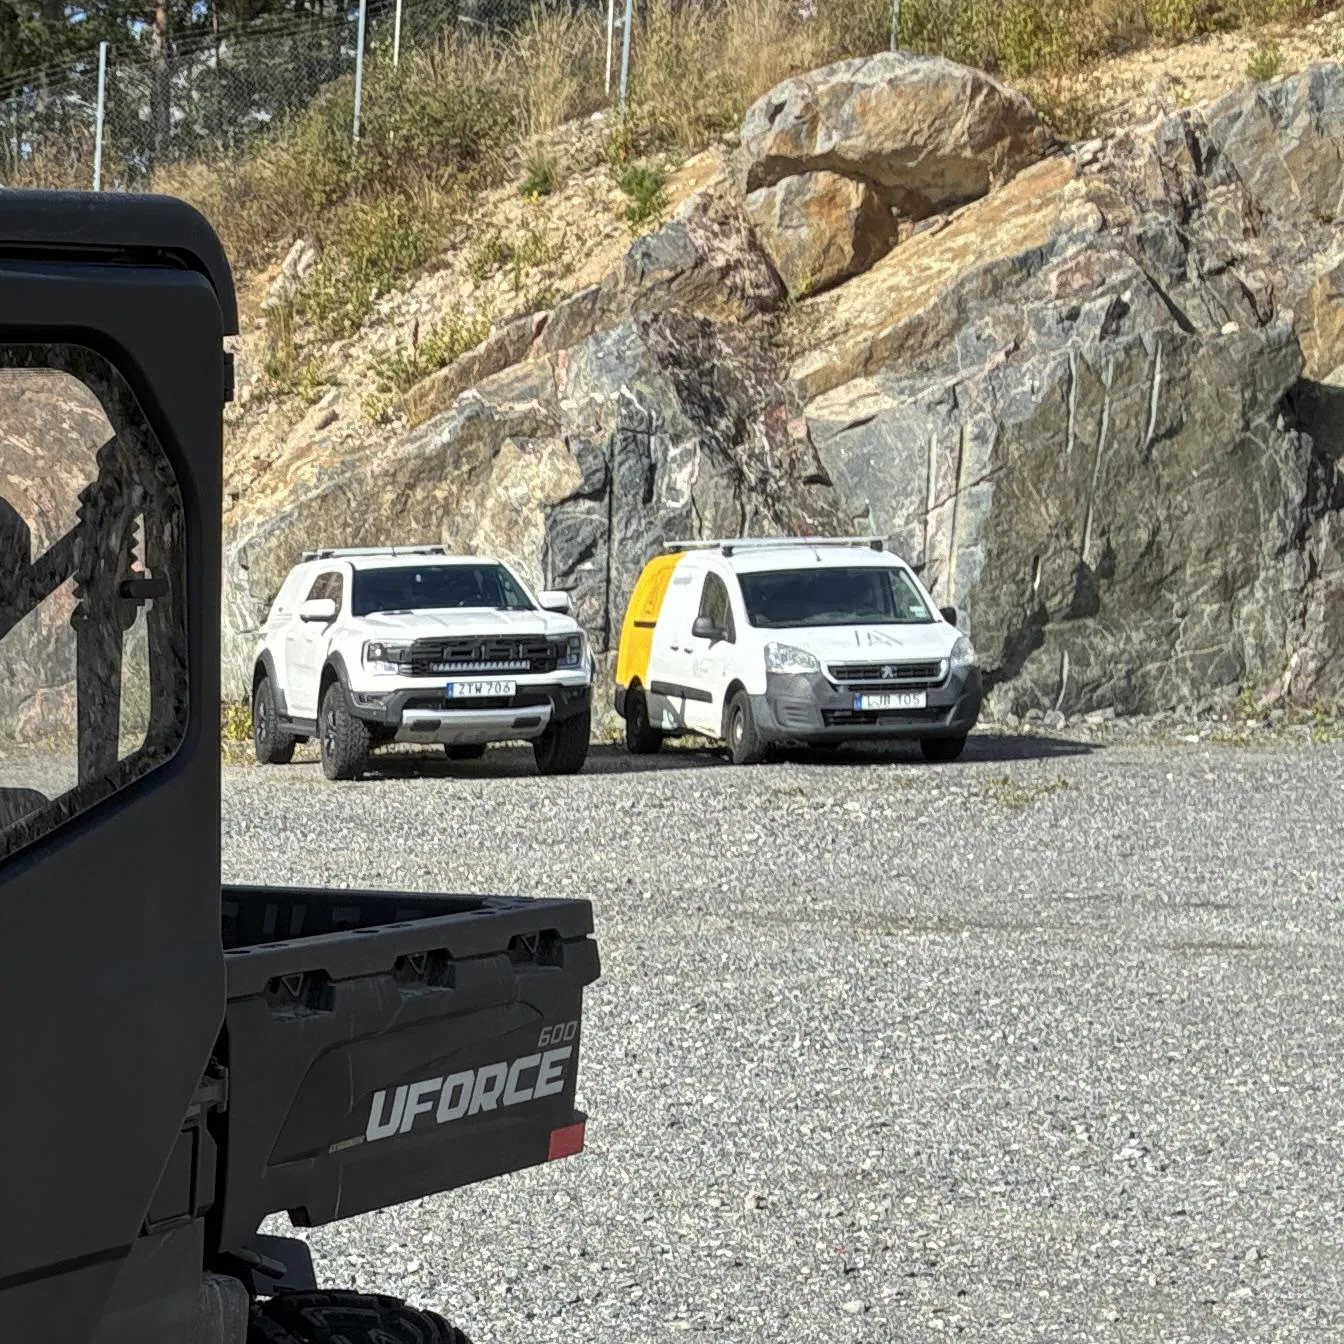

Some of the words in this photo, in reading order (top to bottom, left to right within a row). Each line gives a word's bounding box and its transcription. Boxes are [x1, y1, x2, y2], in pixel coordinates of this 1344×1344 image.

[458, 682, 483, 695] ZTW
[487, 681, 511, 693] 706
[898, 693, 920, 705] 105
[538, 1019, 578, 1048] 600
[366, 1045, 573, 1142] UFORCE
